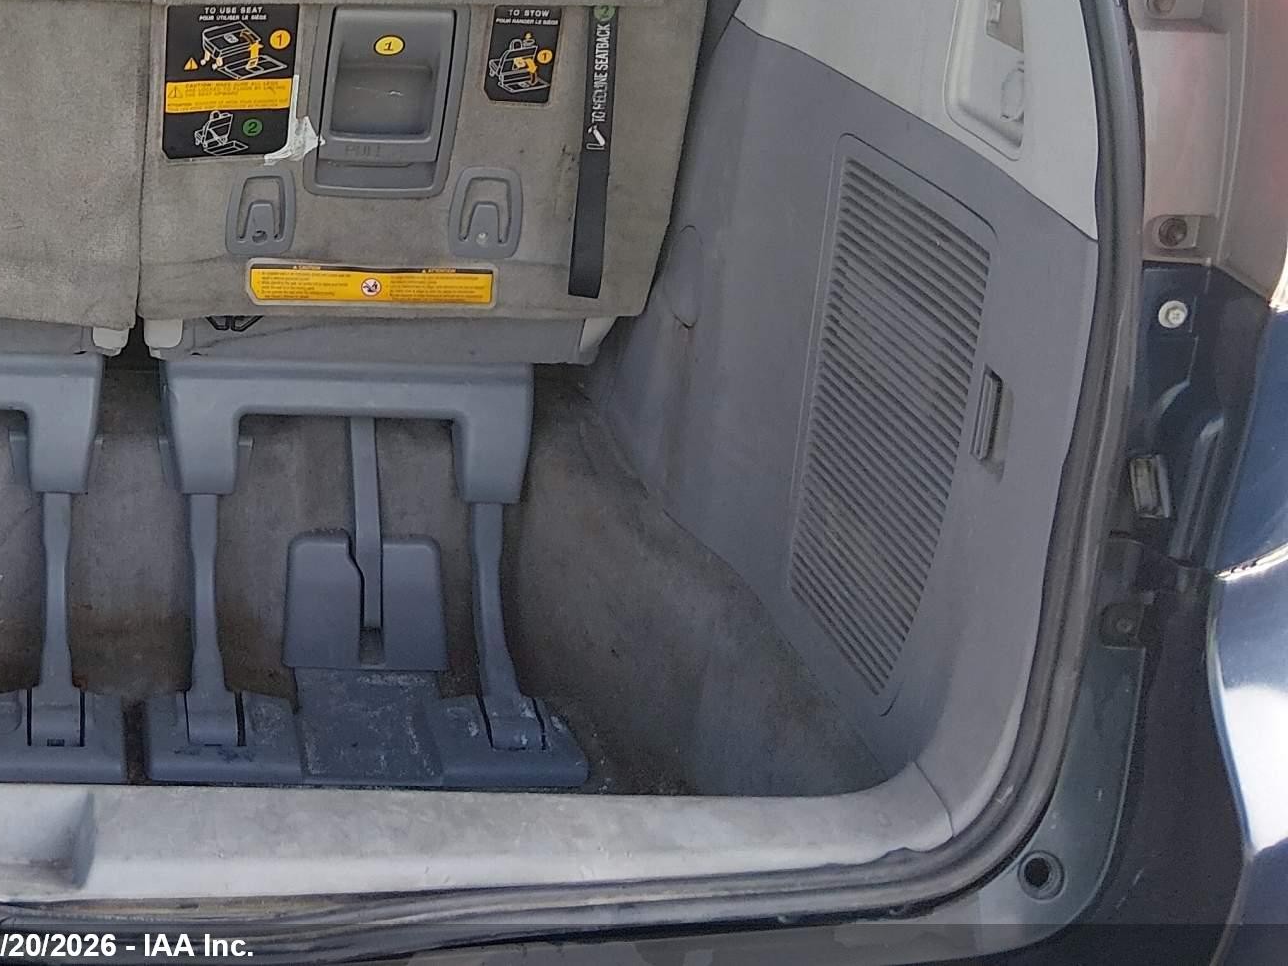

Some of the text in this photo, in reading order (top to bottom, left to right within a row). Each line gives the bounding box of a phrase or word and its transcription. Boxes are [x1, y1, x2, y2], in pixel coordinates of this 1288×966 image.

[219, 6, 237, 14] USE
[508, 9, 550, 17] TO STOW
[384, 41, 394, 51] 1
[594, 23, 611, 71] SEATBACK
[592, 110, 606, 122] TO
[247, 121, 258, 134] 2
